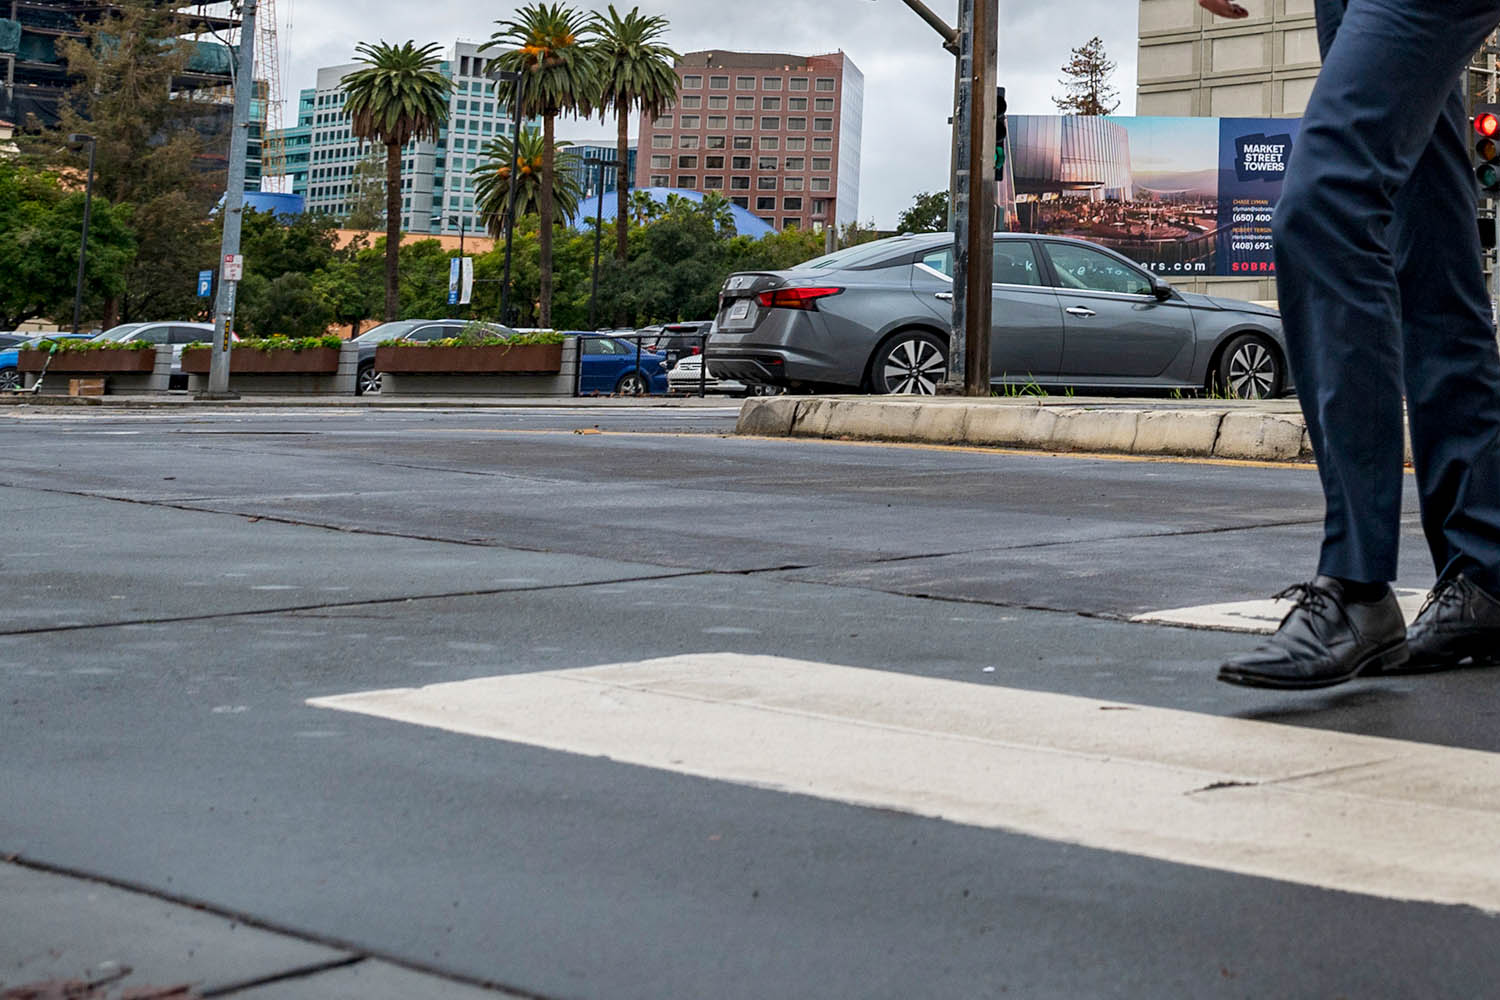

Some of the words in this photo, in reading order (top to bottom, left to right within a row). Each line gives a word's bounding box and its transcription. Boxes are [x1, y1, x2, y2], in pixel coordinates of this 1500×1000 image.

[1243, 144, 1285, 154] MARKET
[1245, 153, 1283, 163] STREET
[1243, 162, 1285, 172] TOWERS
[1232, 213, 1254, 223] (650)
[1231, 241, 1253, 251] (408)
[200, 281, 208, 296] P
